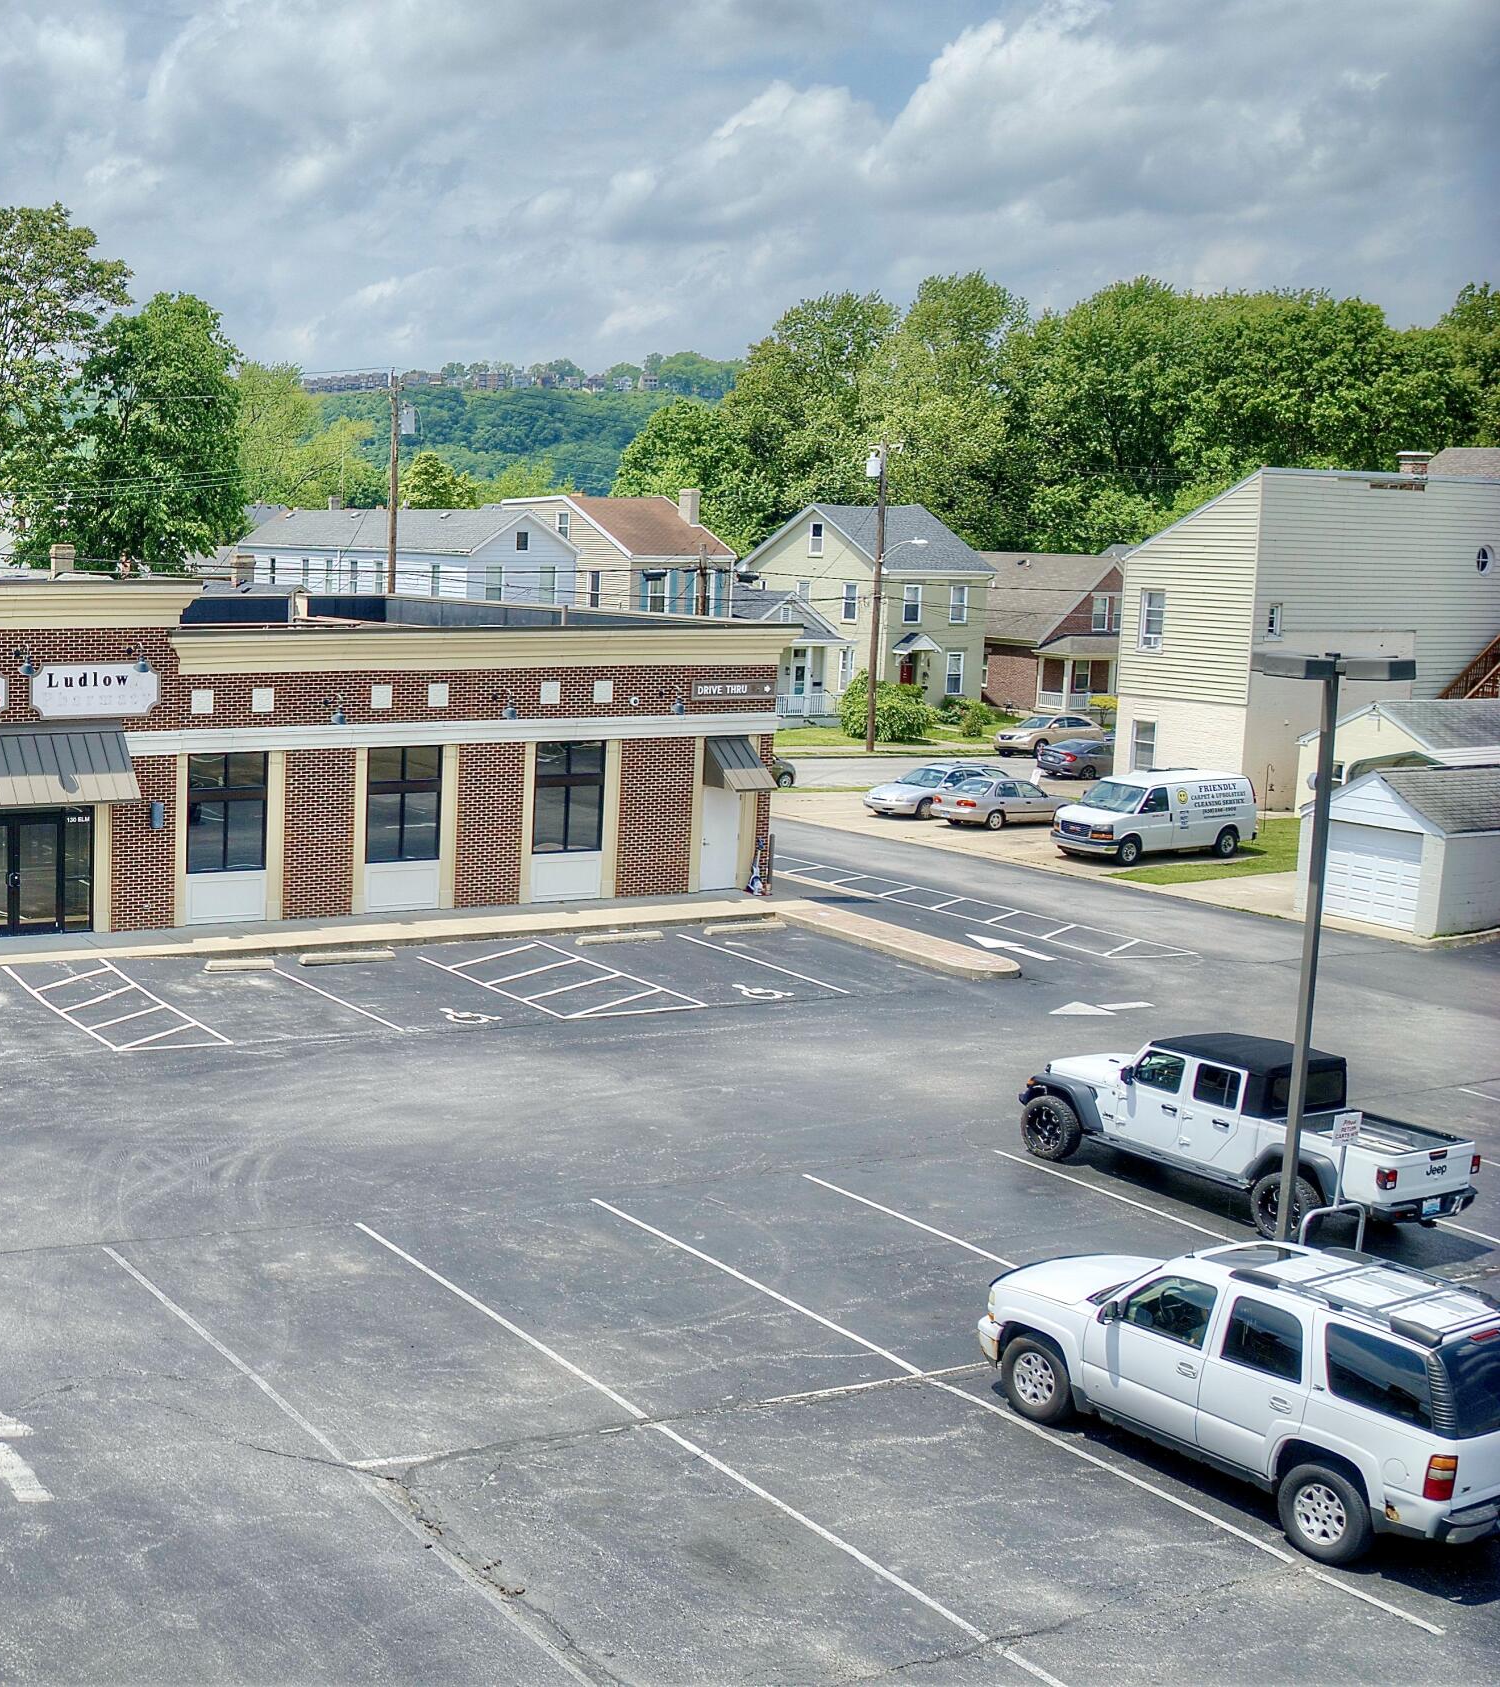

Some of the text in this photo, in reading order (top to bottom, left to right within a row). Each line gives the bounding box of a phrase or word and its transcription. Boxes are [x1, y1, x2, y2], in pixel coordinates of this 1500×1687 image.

[47, 672, 129, 688] Ludlow
[697, 684, 748, 695] DRIVE THRU
[1198, 783, 1237, 793] FRIENDLY
[77, 815, 90, 823] ELM
[1426, 1164, 1447, 1176] Jeep
